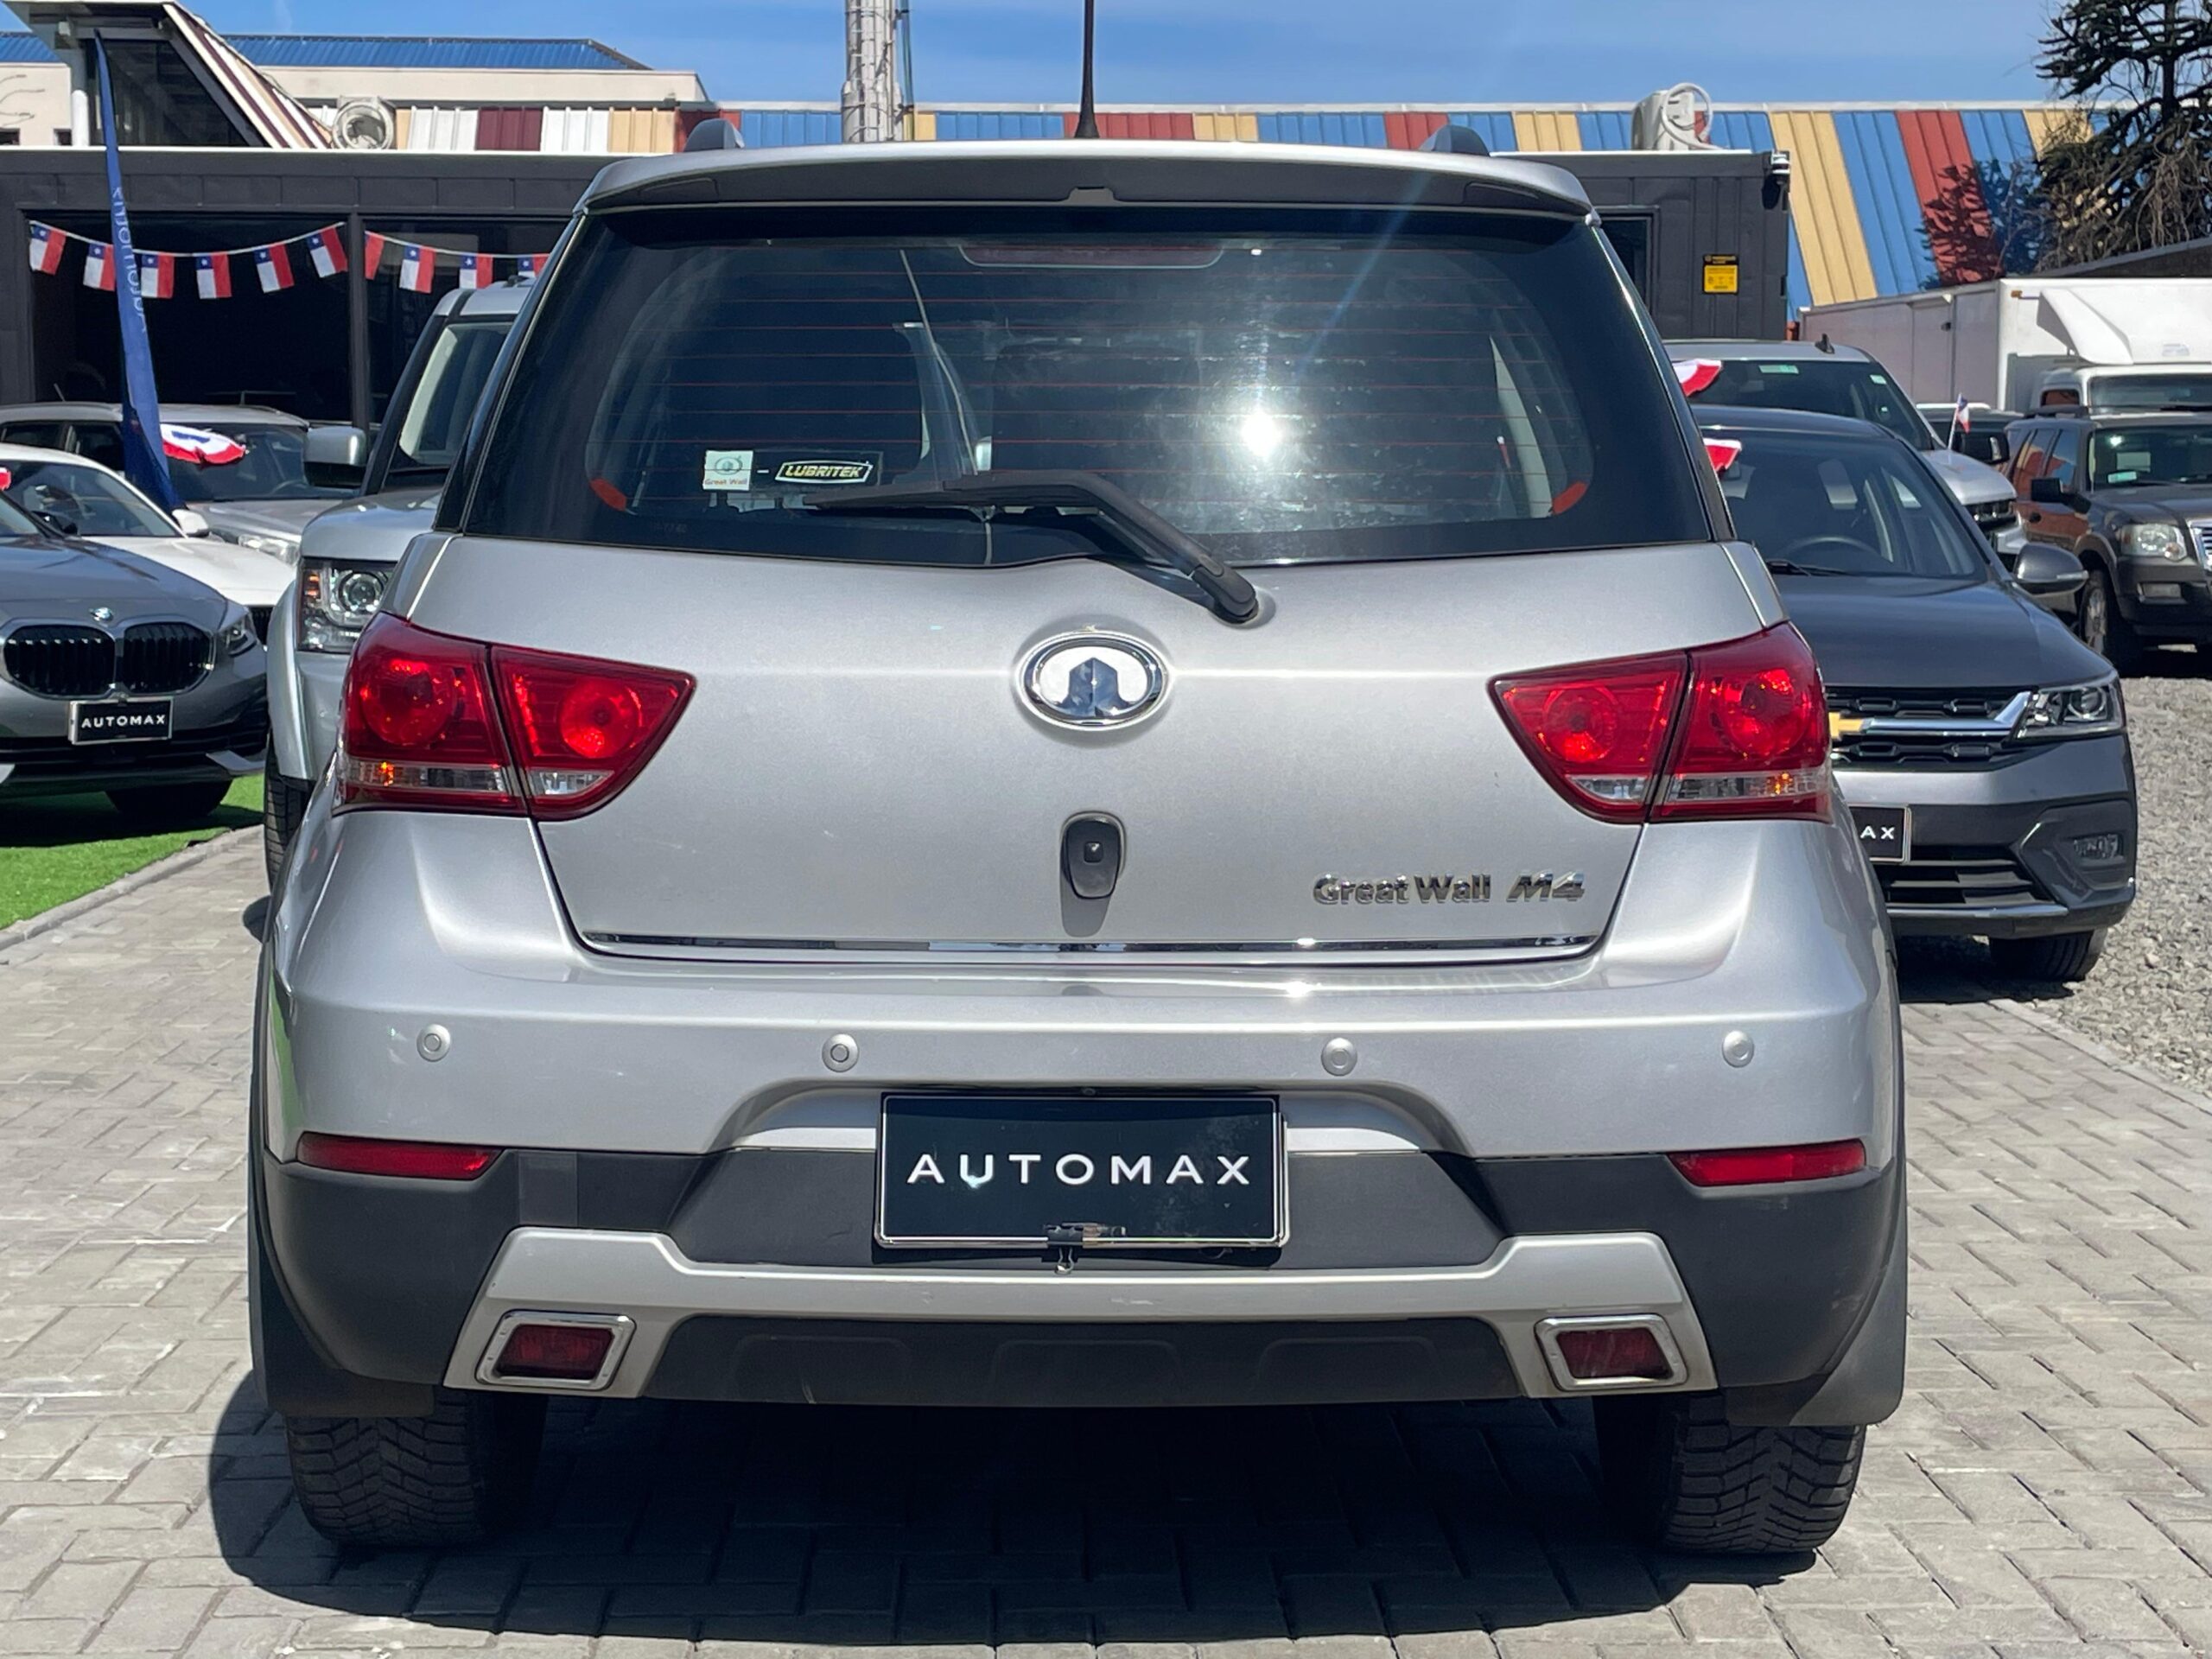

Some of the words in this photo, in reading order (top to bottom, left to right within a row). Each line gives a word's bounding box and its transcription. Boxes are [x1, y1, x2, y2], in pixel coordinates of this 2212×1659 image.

[785, 465, 864, 478] LUBRITEK
[81, 715, 166, 728] AUTOMAX
[1313, 873, 1410, 905] Great
[1414, 872, 1491, 903] Wall
[1505, 868, 1586, 903] M4
[906, 1154, 1250, 1186] AUTOMAX
